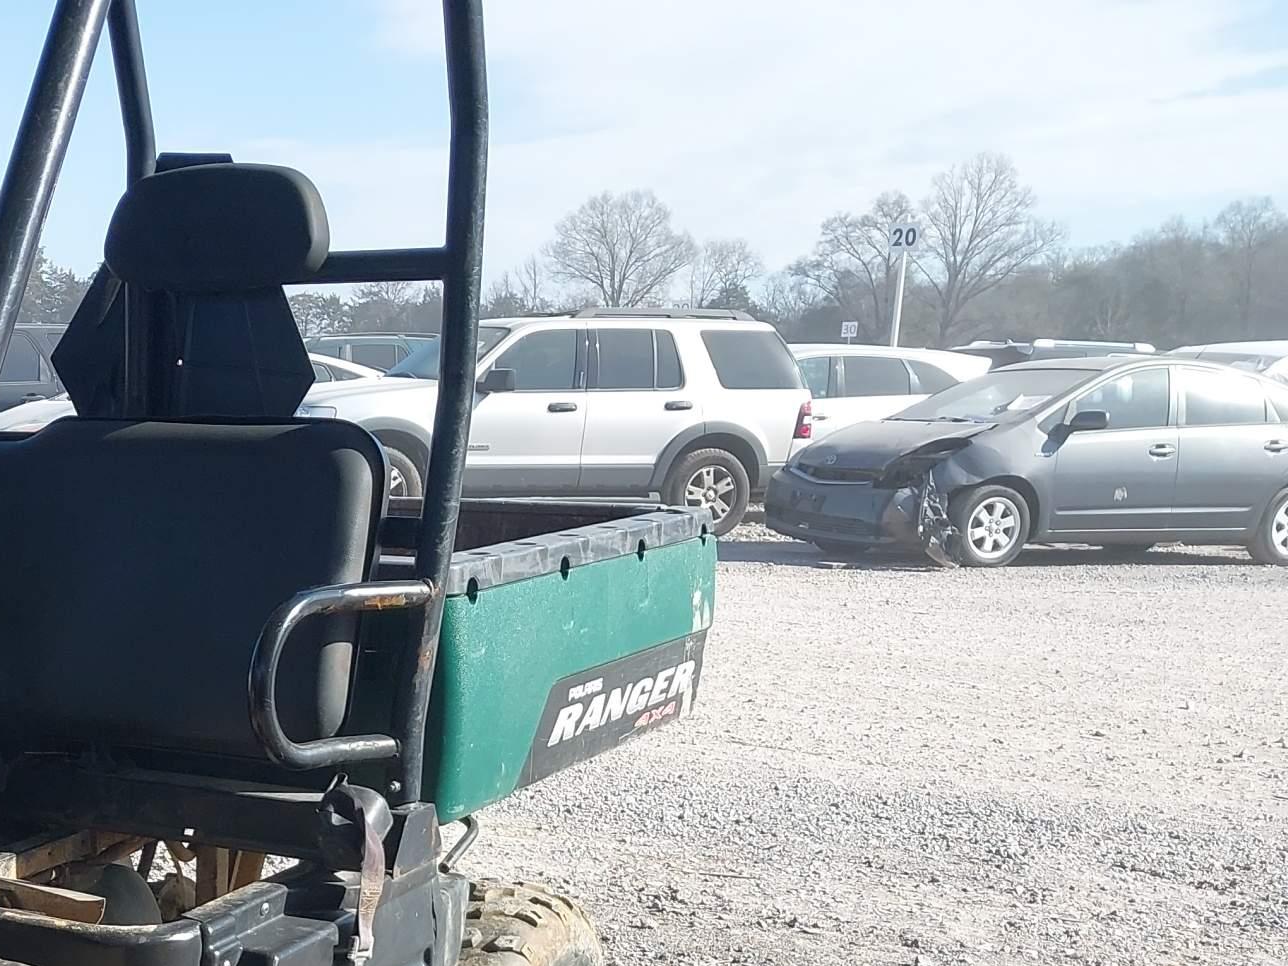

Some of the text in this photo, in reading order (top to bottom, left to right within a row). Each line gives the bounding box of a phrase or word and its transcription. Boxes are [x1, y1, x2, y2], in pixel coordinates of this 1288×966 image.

[892, 228, 917, 247] 20
[842, 324, 857, 335] 30
[547, 660, 697, 748] RANGER
